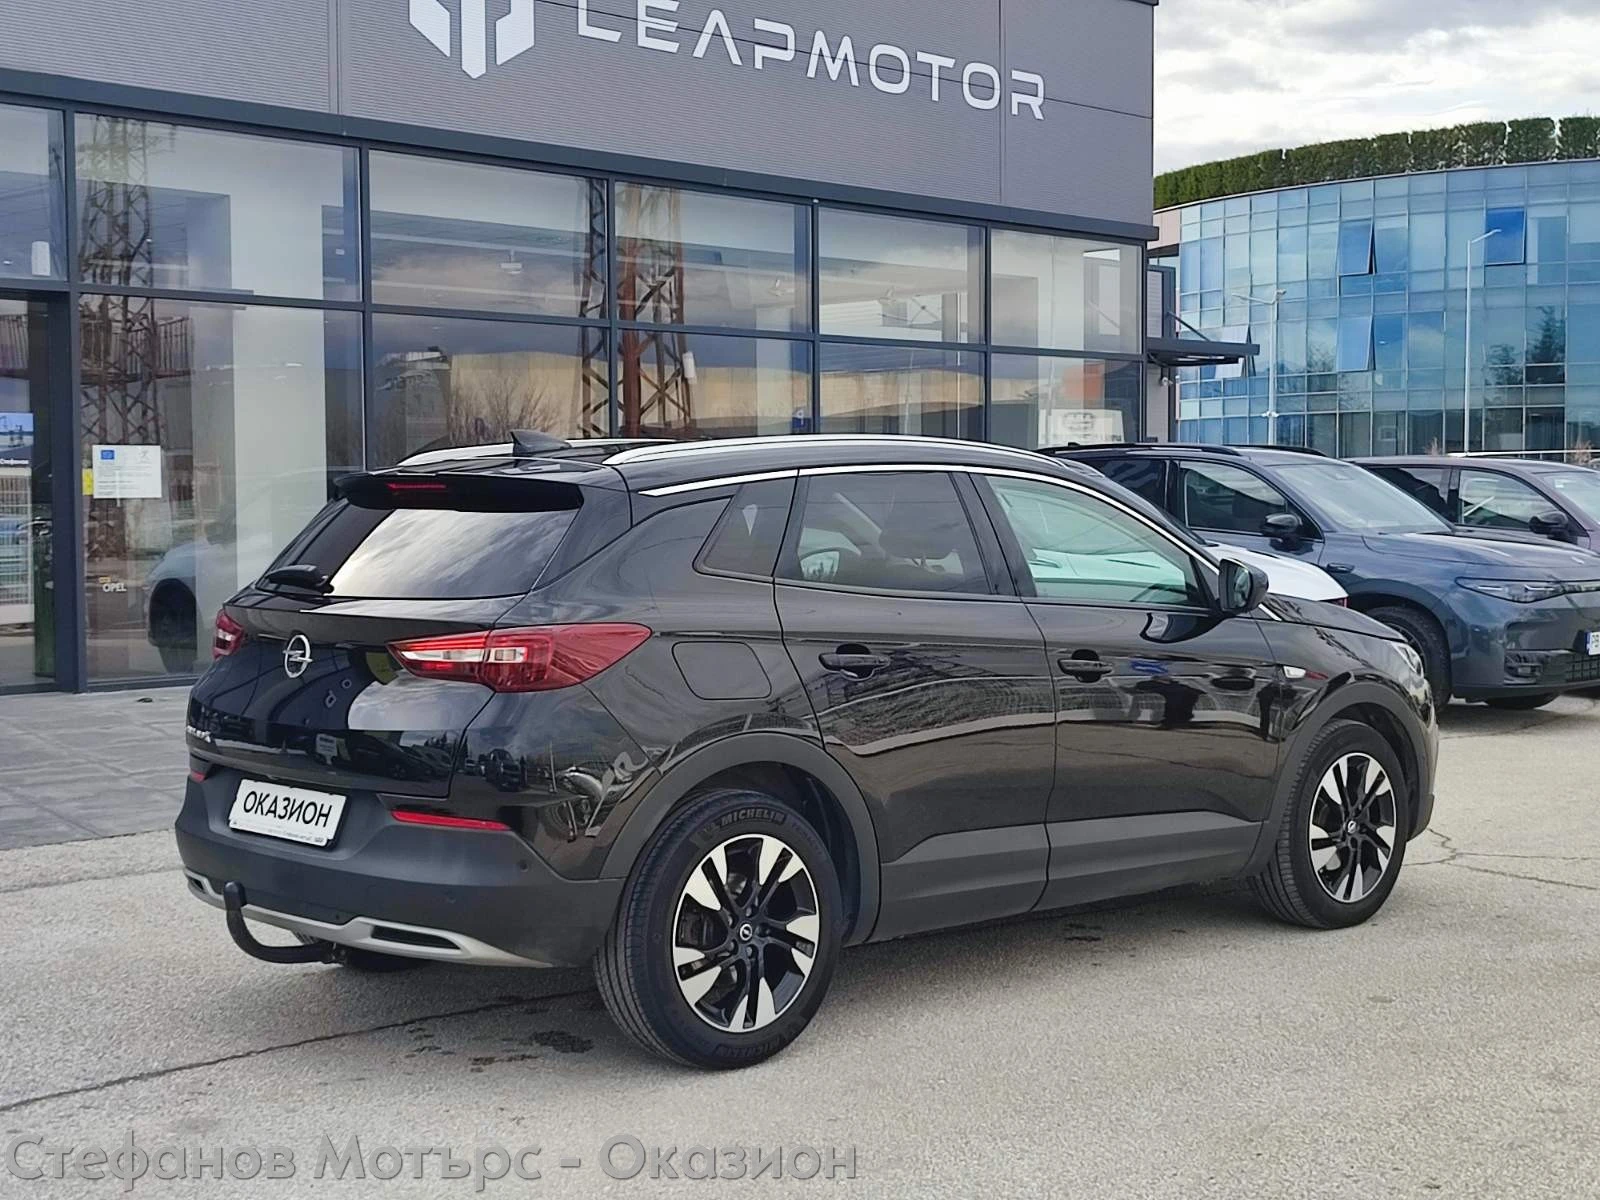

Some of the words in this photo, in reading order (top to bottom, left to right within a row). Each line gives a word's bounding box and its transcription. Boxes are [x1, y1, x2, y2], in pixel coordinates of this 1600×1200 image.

[578, 0, 1045, 120] LEAPMOTOR
[102, 582, 127, 592] OPEL
[243, 790, 332, 827] ОКАЗИОН
[721, 808, 785, 825] MICHELIN
